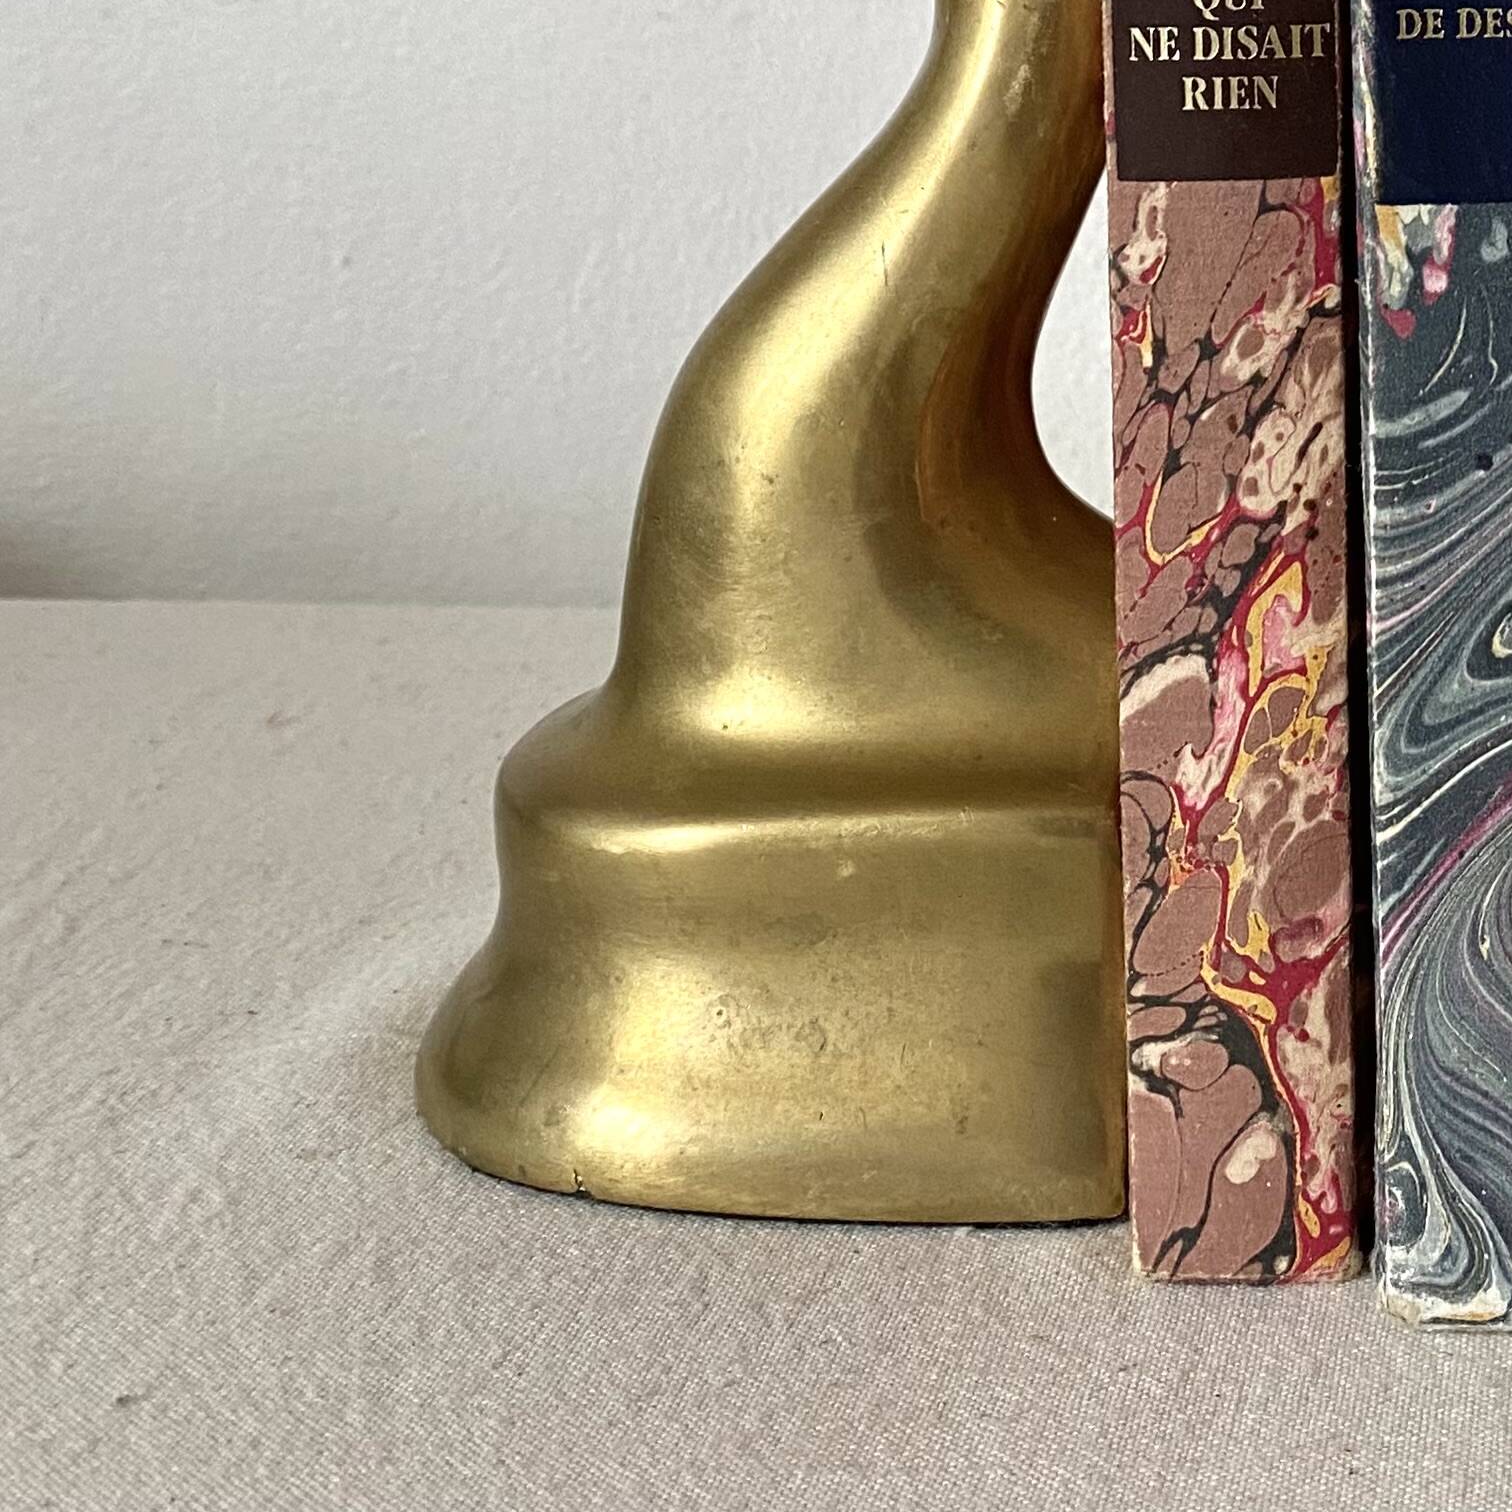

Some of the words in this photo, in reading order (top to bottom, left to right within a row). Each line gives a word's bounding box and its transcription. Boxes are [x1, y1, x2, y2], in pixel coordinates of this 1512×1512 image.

[1128, 26, 1181, 63] NE
[1192, 21, 1331, 61] DISAIT
[1396, 8, 1445, 40] DE
[1181, 75, 1279, 111] RIEN
